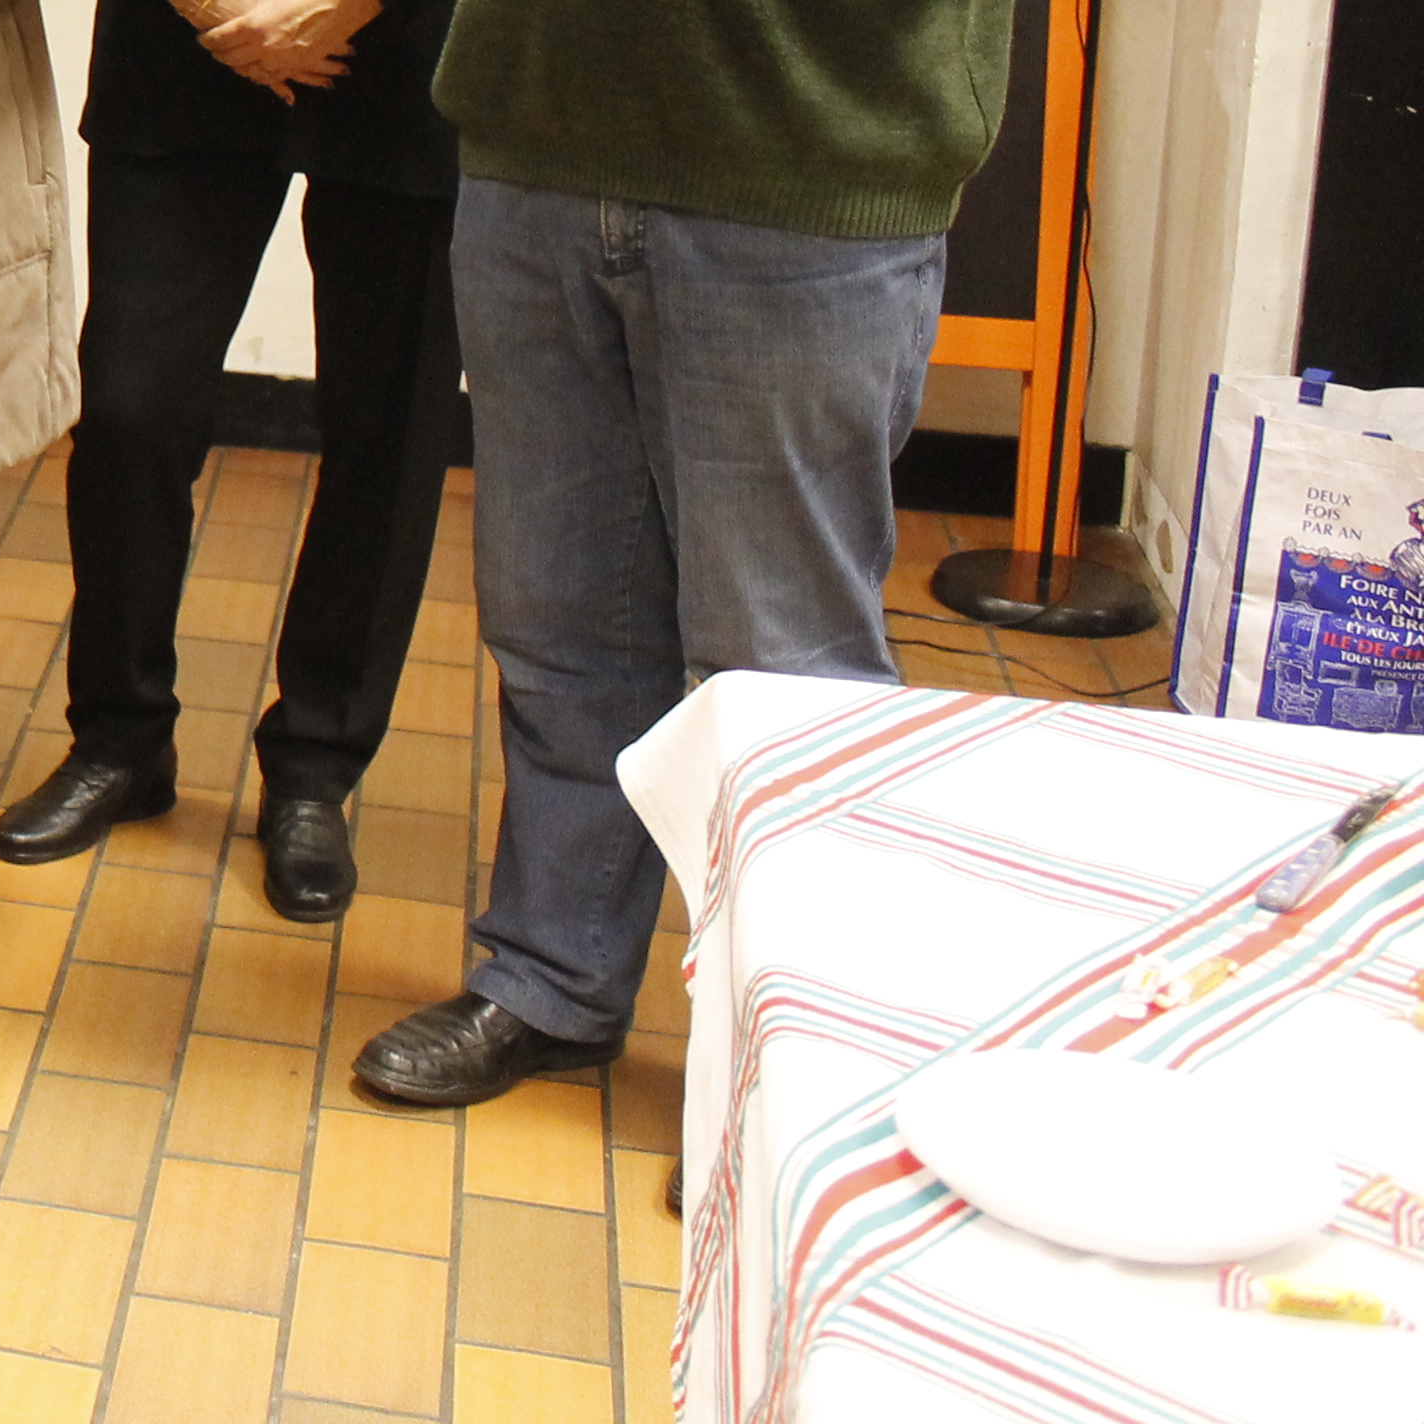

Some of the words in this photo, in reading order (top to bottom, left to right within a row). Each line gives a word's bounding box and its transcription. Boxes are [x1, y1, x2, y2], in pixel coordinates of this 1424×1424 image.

[1307, 487, 1352, 507] DEUX
[1304, 503, 1341, 521] FOIS
[1302, 520, 1333, 536] PAR
[1337, 526, 1363, 541] AN
[1340, 574, 1398, 600] FOIRE
[1346, 595, 1379, 610] AUX
[1366, 611, 1385, 625] LA
[1346, 621, 1367, 635] ET
[1366, 627, 1400, 643] AUX
[1357, 638, 1386, 657] DE
[1340, 650, 1372, 666] TOUS
[1373, 657, 1391, 668] LES
